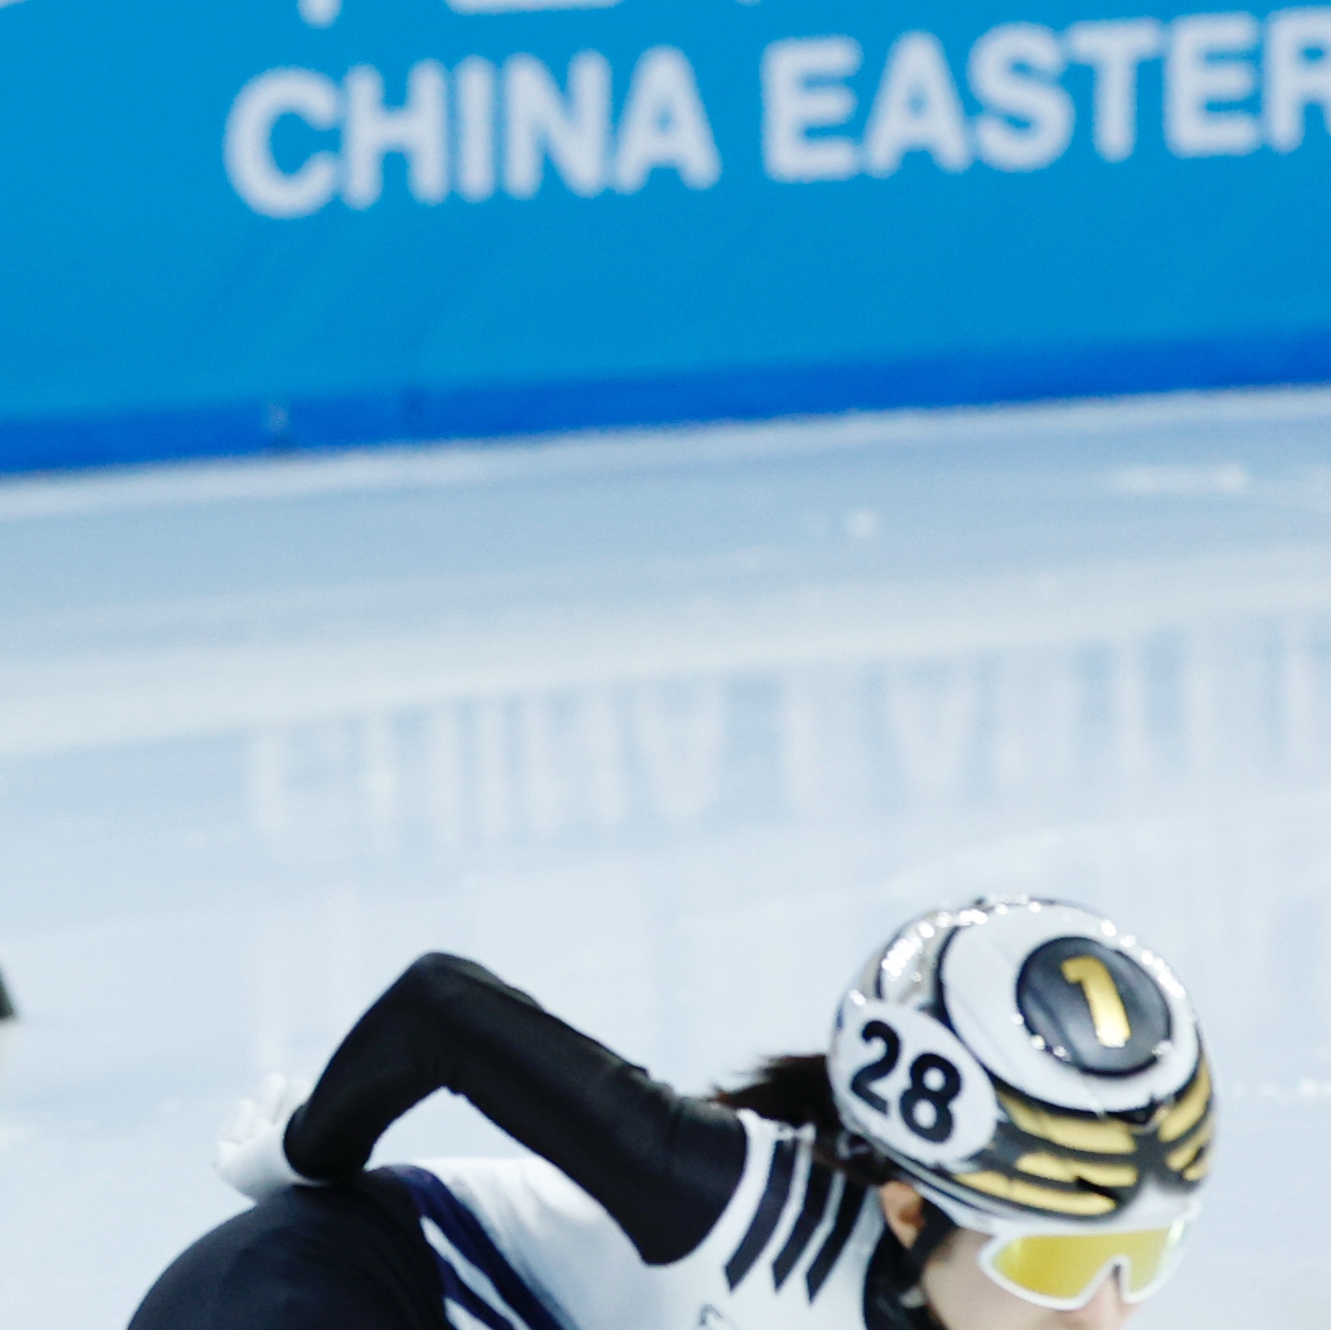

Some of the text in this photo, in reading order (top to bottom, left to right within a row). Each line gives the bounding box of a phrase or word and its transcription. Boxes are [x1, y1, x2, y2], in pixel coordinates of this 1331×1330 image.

[221, 2, 1331, 219] CHINA EASTER
[1059, 954, 1132, 1048] 1
[850, 1020, 962, 1145] 28
